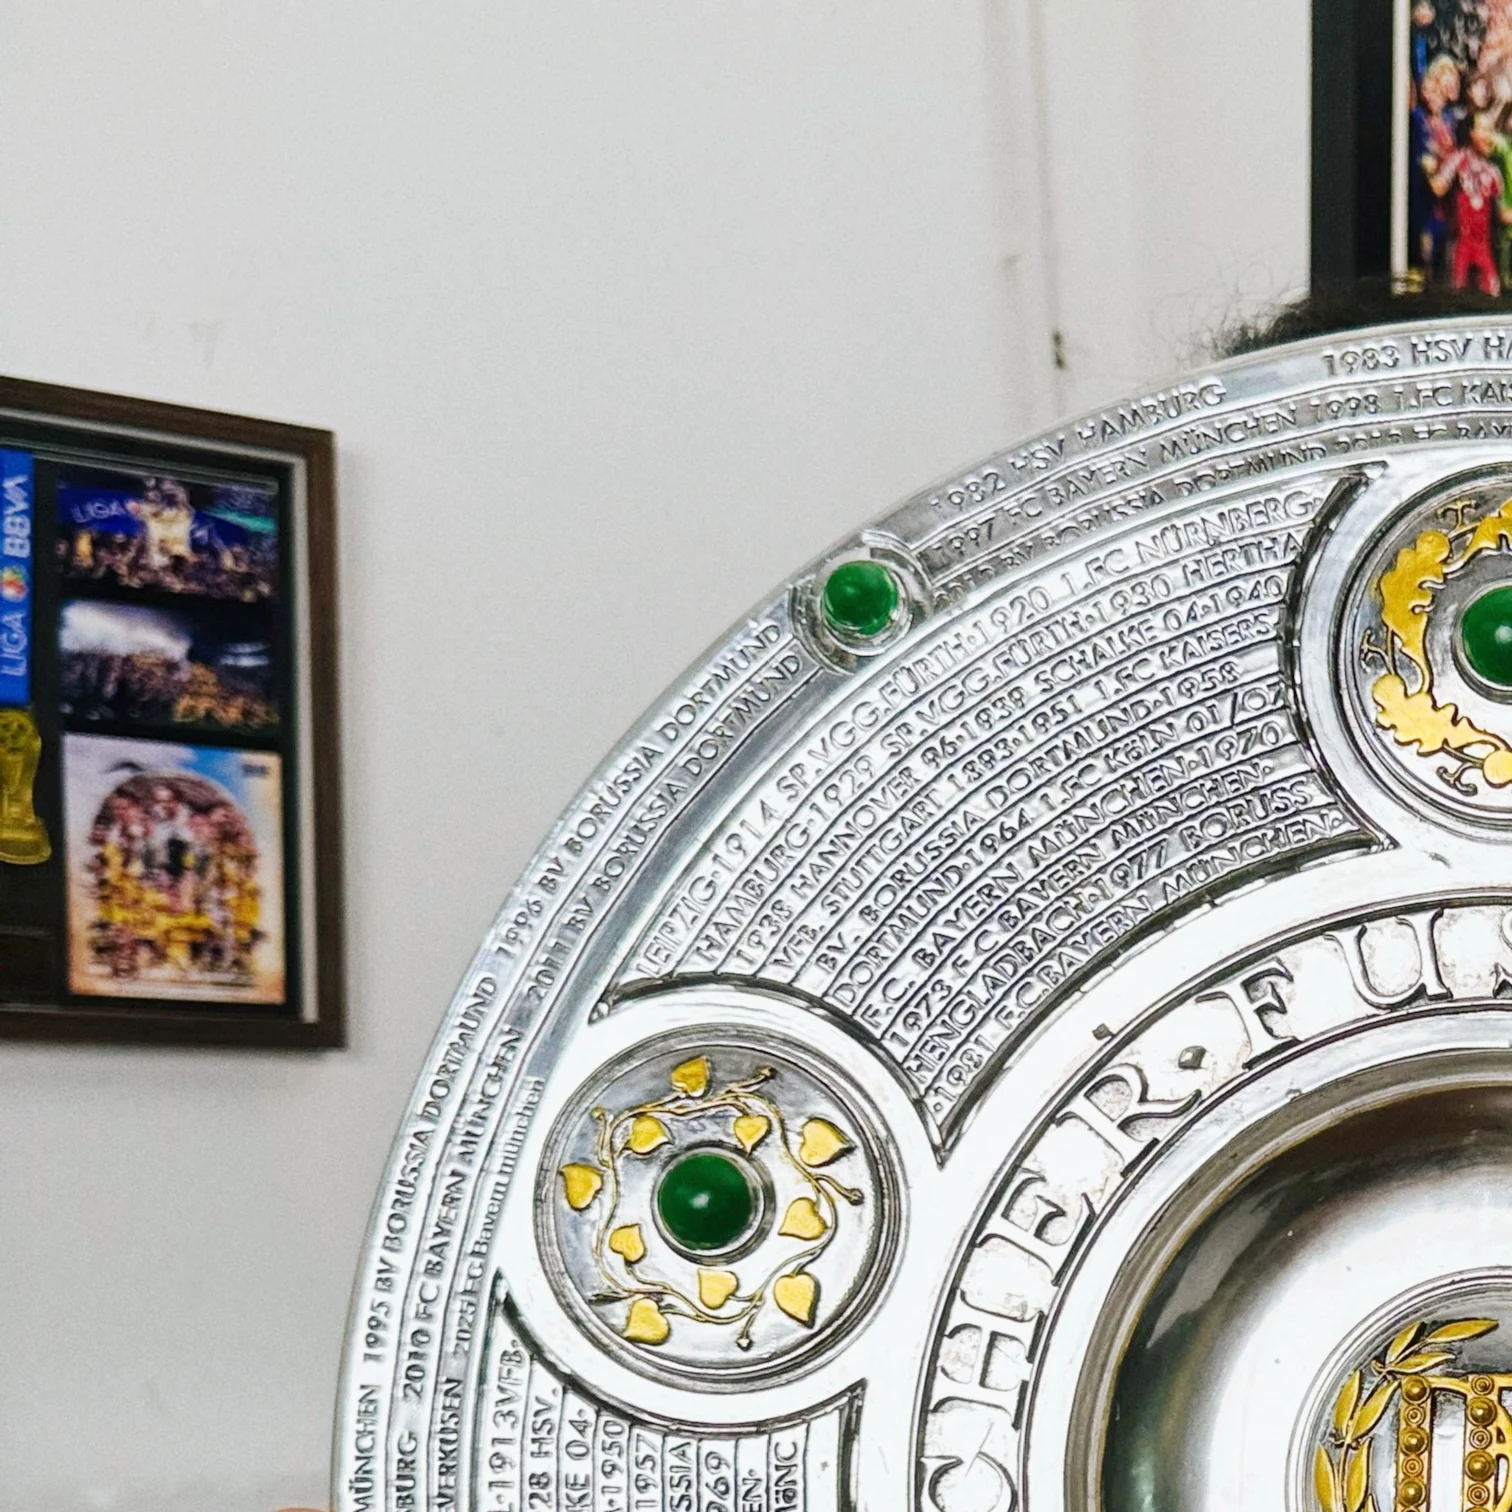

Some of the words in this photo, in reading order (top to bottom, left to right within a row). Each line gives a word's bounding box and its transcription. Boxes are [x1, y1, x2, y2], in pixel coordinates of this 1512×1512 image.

[1409, 334, 1475, 366] HSV
[1009, 434, 1072, 482] HSV
[1073, 374, 1229, 452] HAMBURG
[2, 474, 32, 559] BBVA
[1, 611, 28, 678] LIGA
[493, 893, 547, 964] 1996
[534, 854, 572, 895] BV
[560, 735, 664, 859] BORUSSIA
[655, 616, 787, 746] DORTMUND
[563, 894, 600, 935] BV
[589, 773, 690, 895] BORUSSIA
[678, 651, 809, 780] DORTMUND
[854, 802, 988, 928] BORUSSIA
[906, 858, 1026, 972] BAYERN
[886, 973, 955, 1050] 1973
[990, 839, 1108, 936] BAYERN
[420, 971, 502, 1121] DORTMUND
[380, 1124, 436, 1253] BORUSSIA
[371, 1255, 400, 1293] BV
[413, 1282, 442, 1321] FC
[360, 1296, 393, 1364] 1995
[401, 1327, 433, 1399] 2010
